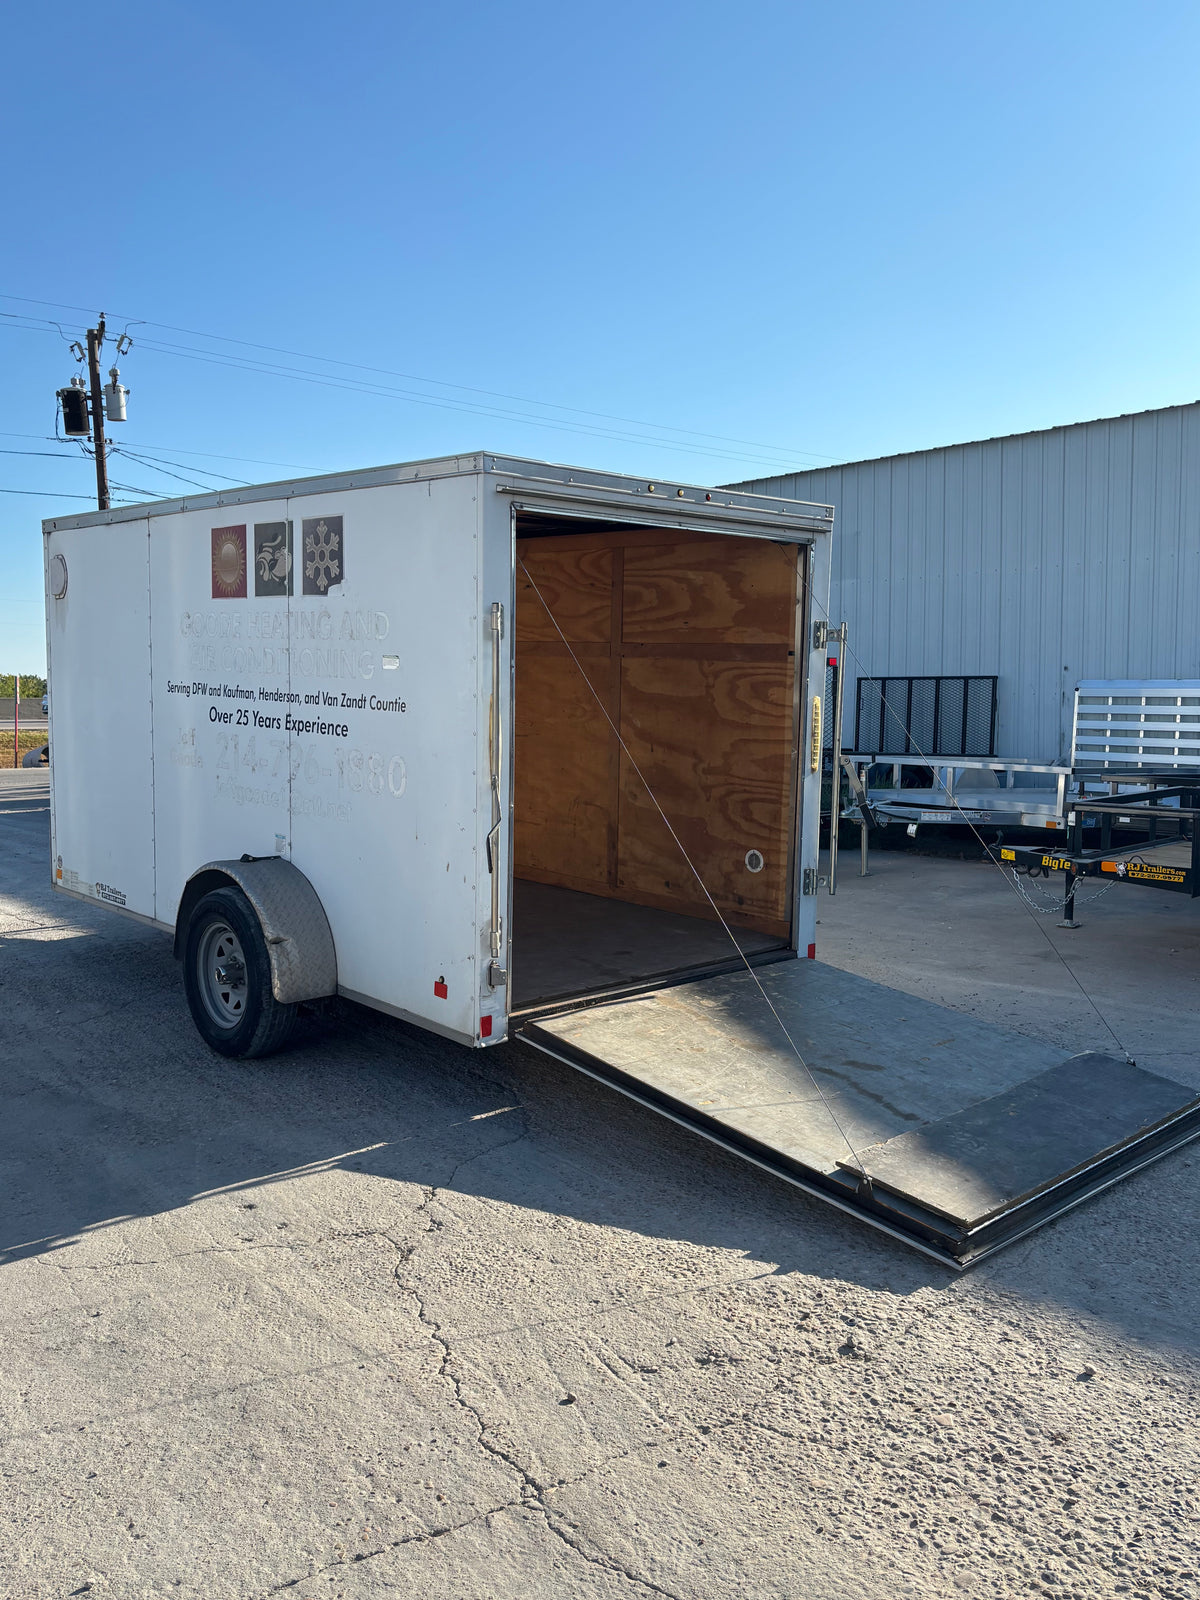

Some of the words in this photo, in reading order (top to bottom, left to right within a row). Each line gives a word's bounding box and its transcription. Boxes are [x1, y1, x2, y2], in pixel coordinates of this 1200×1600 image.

[247, 609, 333, 640] HEATING
[338, 610, 390, 640] AND
[222, 646, 375, 680] CONDITIONING
[167, 681, 191, 698] Serving
[192, 682, 208, 695] DFW
[208, 684, 221, 697] and
[223, 685, 256, 703] Kaufman,
[258, 687, 302, 705] Henderson,
[304, 690, 320, 705] and
[321, 691, 338, 707] Van
[340, 693, 367, 709] Zandt
[369, 695, 407, 713] Countie
[209, 706, 233, 724] Over
[236, 709, 249, 726] 25
[252, 710, 281, 731] Years
[285, 713, 349, 737] Experience
[1041, 855, 1071, 870] BigTe
[1127, 863, 1140, 871] RJ
